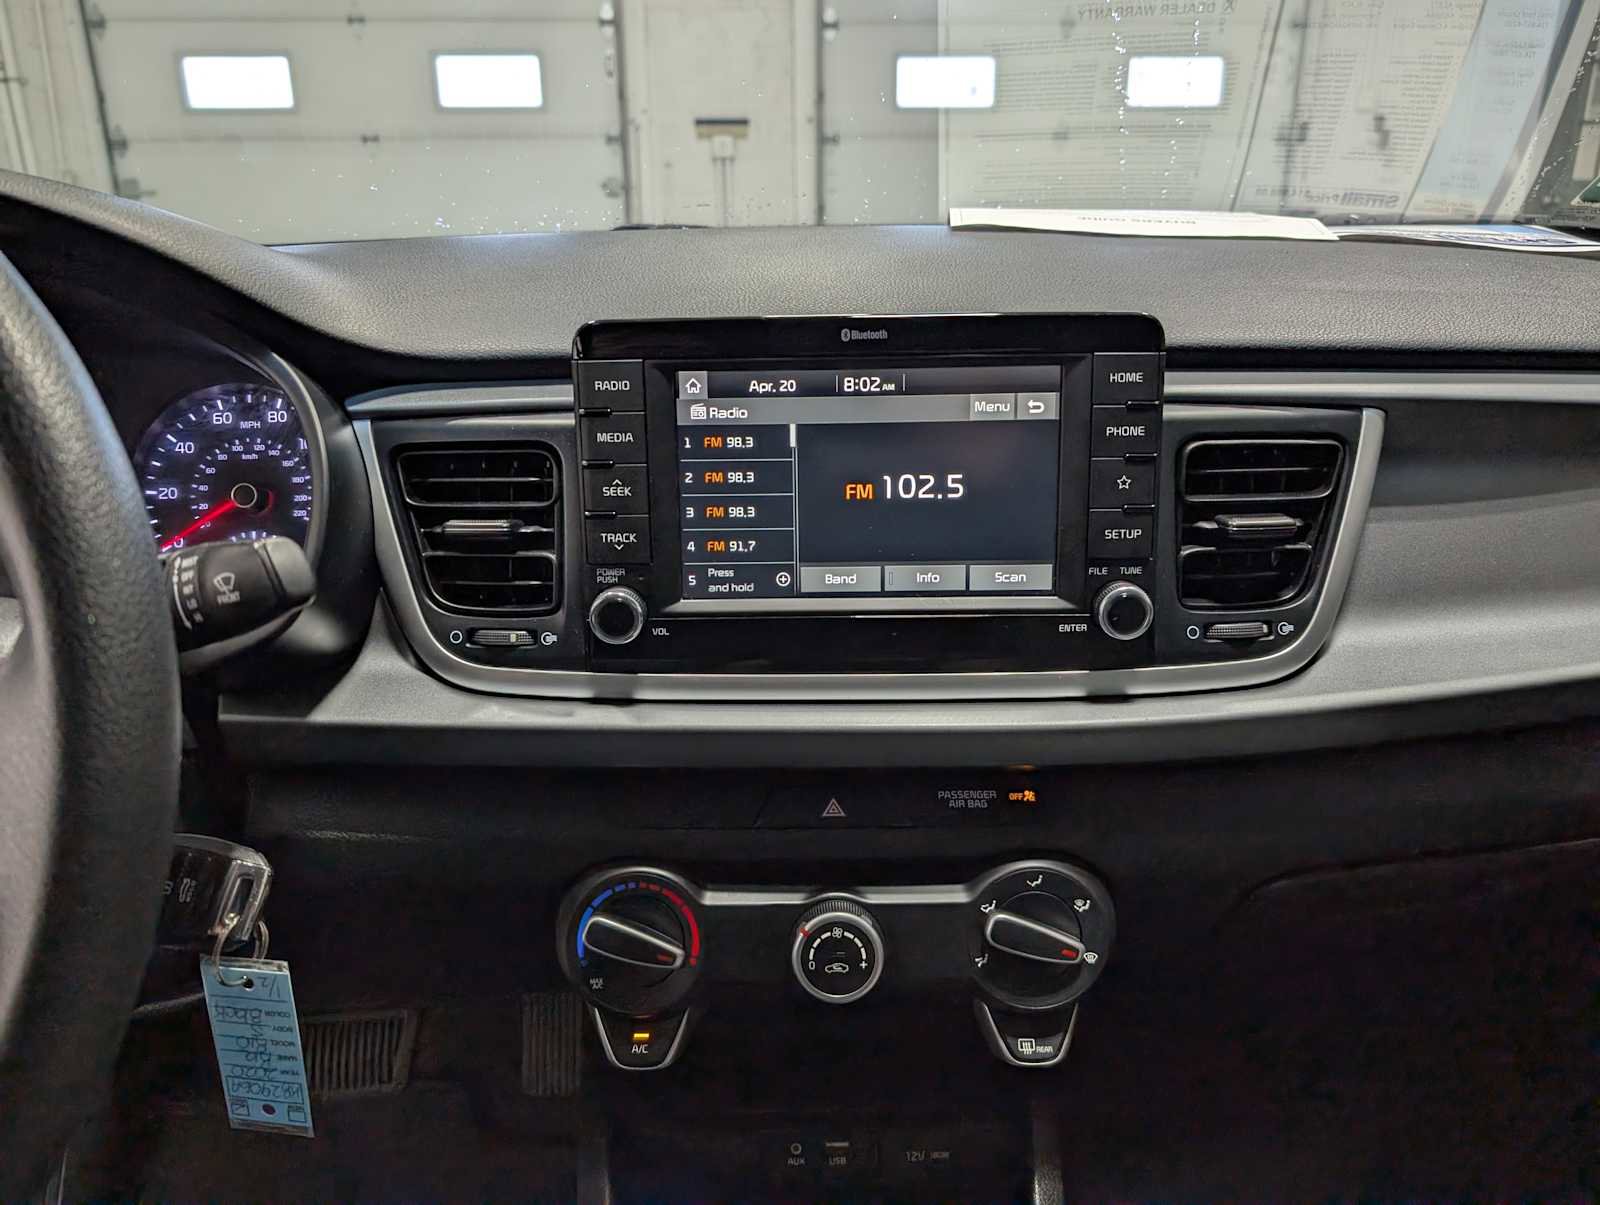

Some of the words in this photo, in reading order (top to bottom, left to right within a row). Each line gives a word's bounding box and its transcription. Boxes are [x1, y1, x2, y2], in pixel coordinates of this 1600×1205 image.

[850, 328, 888, 341] Bluetooth
[1109, 372, 1143, 384] HOME
[594, 380, 630, 391] RADIO
[749, 379, 776, 393] Apr.
[779, 379, 797, 392] 20
[843, 376, 881, 392] 8:02
[882, 382, 896, 391] AM
[974, 401, 1010, 413] Menu
[212, 411, 233, 425] 60
[267, 410, 287, 423] 80
[709, 407, 748, 419] Radio
[240, 421, 261, 429] MPH
[1105, 425, 1145, 437] PHONE
[596, 432, 634, 443] MEDIA
[683, 437, 691, 448] 1
[703, 437, 723, 448] FM
[726, 437, 754, 448] 98.3
[175, 441, 195, 454] 40
[684, 472, 693, 484] 2
[704, 472, 723, 483] FM
[727, 472, 755, 483] 98.3
[602, 486, 632, 497] SEEK
[845, 483, 874, 500] FM
[882, 473, 965, 500] 102.5
[159, 487, 178, 500] 20
[685, 507, 694, 518] 3
[706, 507, 725, 518] FM
[728, 507, 756, 518] 98.3
[600, 533, 638, 543] TRACK
[1104, 528, 1142, 540] SETUP
[686, 541, 696, 552] 4
[706, 541, 726, 552] FM
[729, 540, 756, 552] 91.7
[596, 568, 626, 576] POWER
[707, 568, 735, 578] Press
[1088, 567, 1109, 576] FILE
[1119, 566, 1143, 576] TUNE
[596, 576, 618, 584] PUSH
[688, 575, 697, 586] 5
[824, 573, 858, 584] Band
[916, 571, 941, 583] Info
[994, 571, 1027, 583] Scan
[708, 582, 729, 592] and
[731, 582, 755, 592] hold
[651, 627, 670, 636] VOL
[1058, 623, 1088, 633] ENTER
[937, 790, 998, 799] PASSENGER
[1008, 792, 1024, 801] OFF
[949, 800, 966, 808] AIR
[967, 800, 988, 808] BAG
[631, 1043, 649, 1054] A/C
[1036, 1046, 1054, 1054] REAR
[787, 1157, 806, 1166] AUX
[828, 1156, 847, 1166] USB
